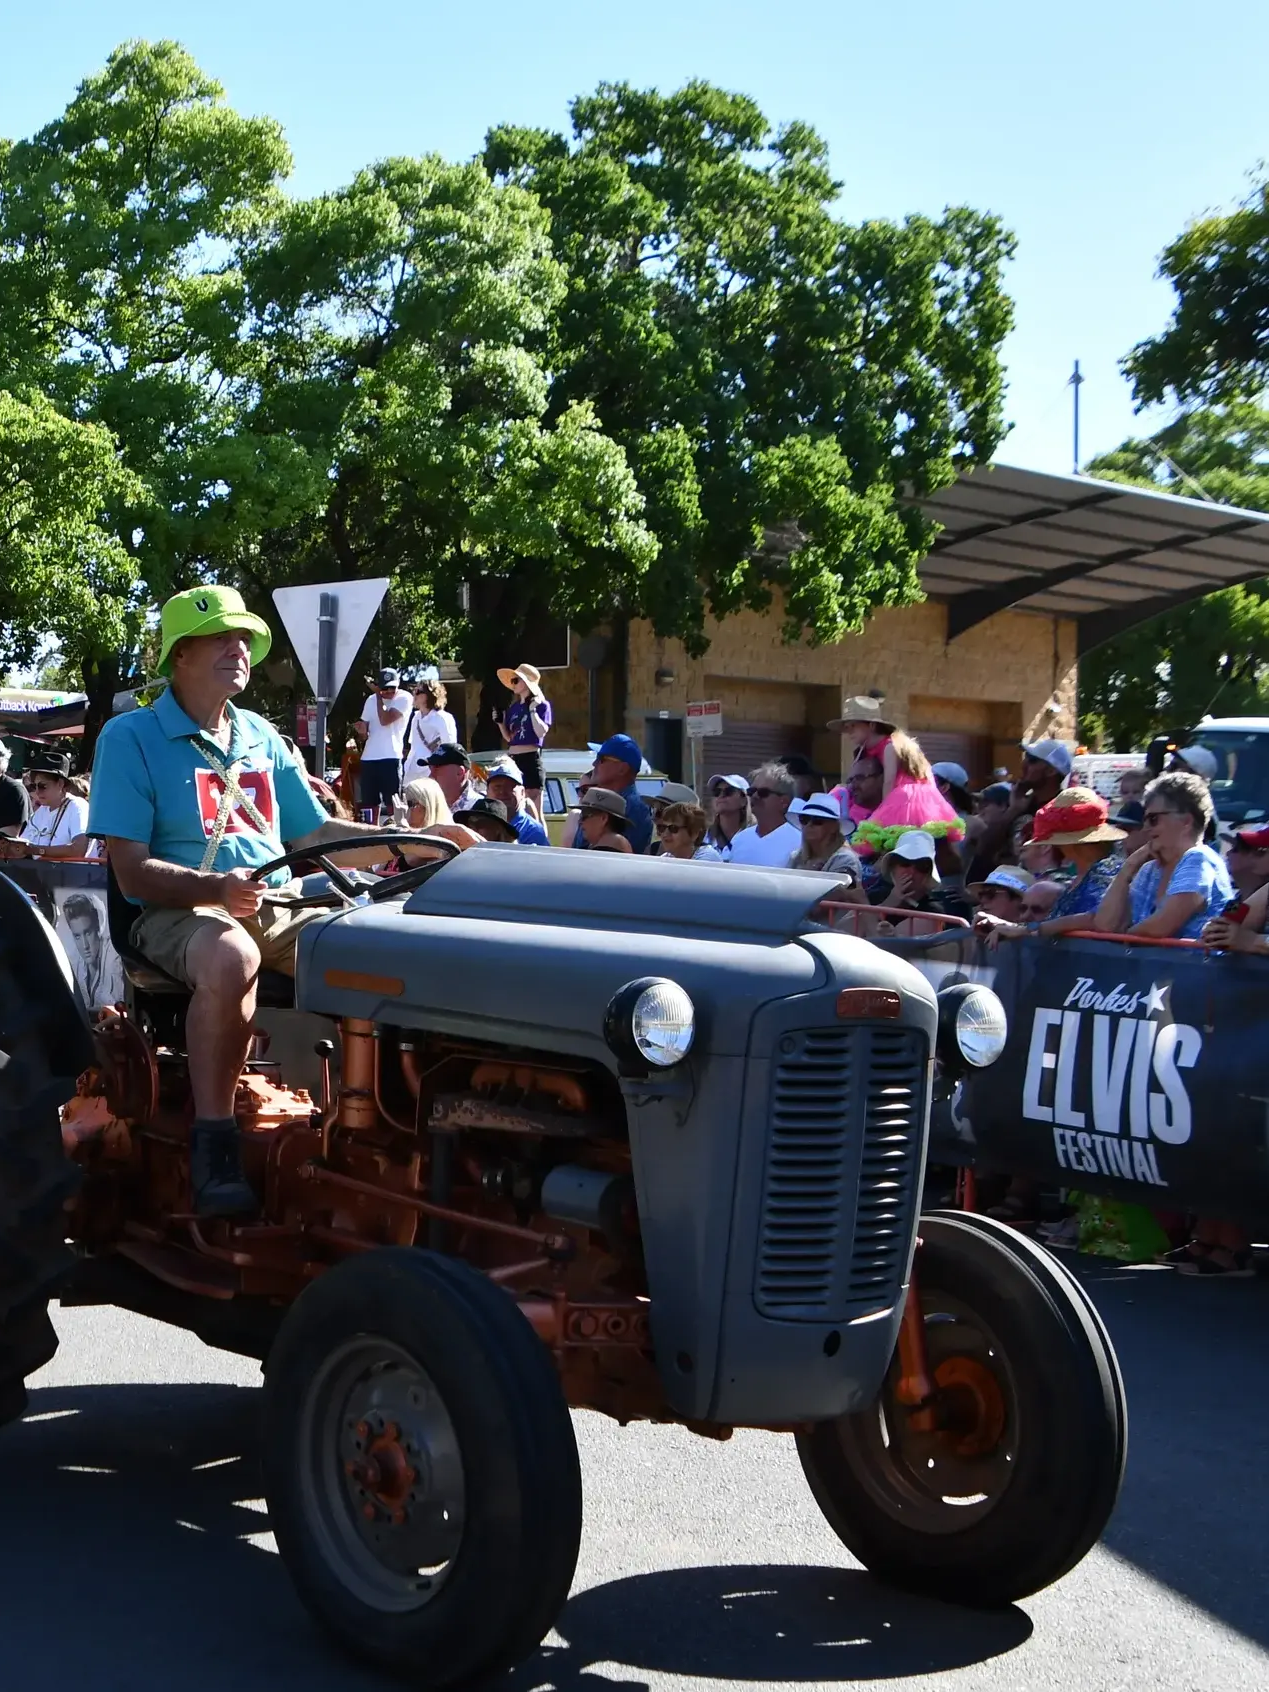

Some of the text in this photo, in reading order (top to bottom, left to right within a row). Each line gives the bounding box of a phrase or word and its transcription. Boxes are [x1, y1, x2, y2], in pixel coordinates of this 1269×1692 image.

[1063, 977, 1141, 1014] Parkes
[1022, 1007, 1203, 1145] ELVIS
[1052, 1127, 1169, 1187] FESTIVAL
